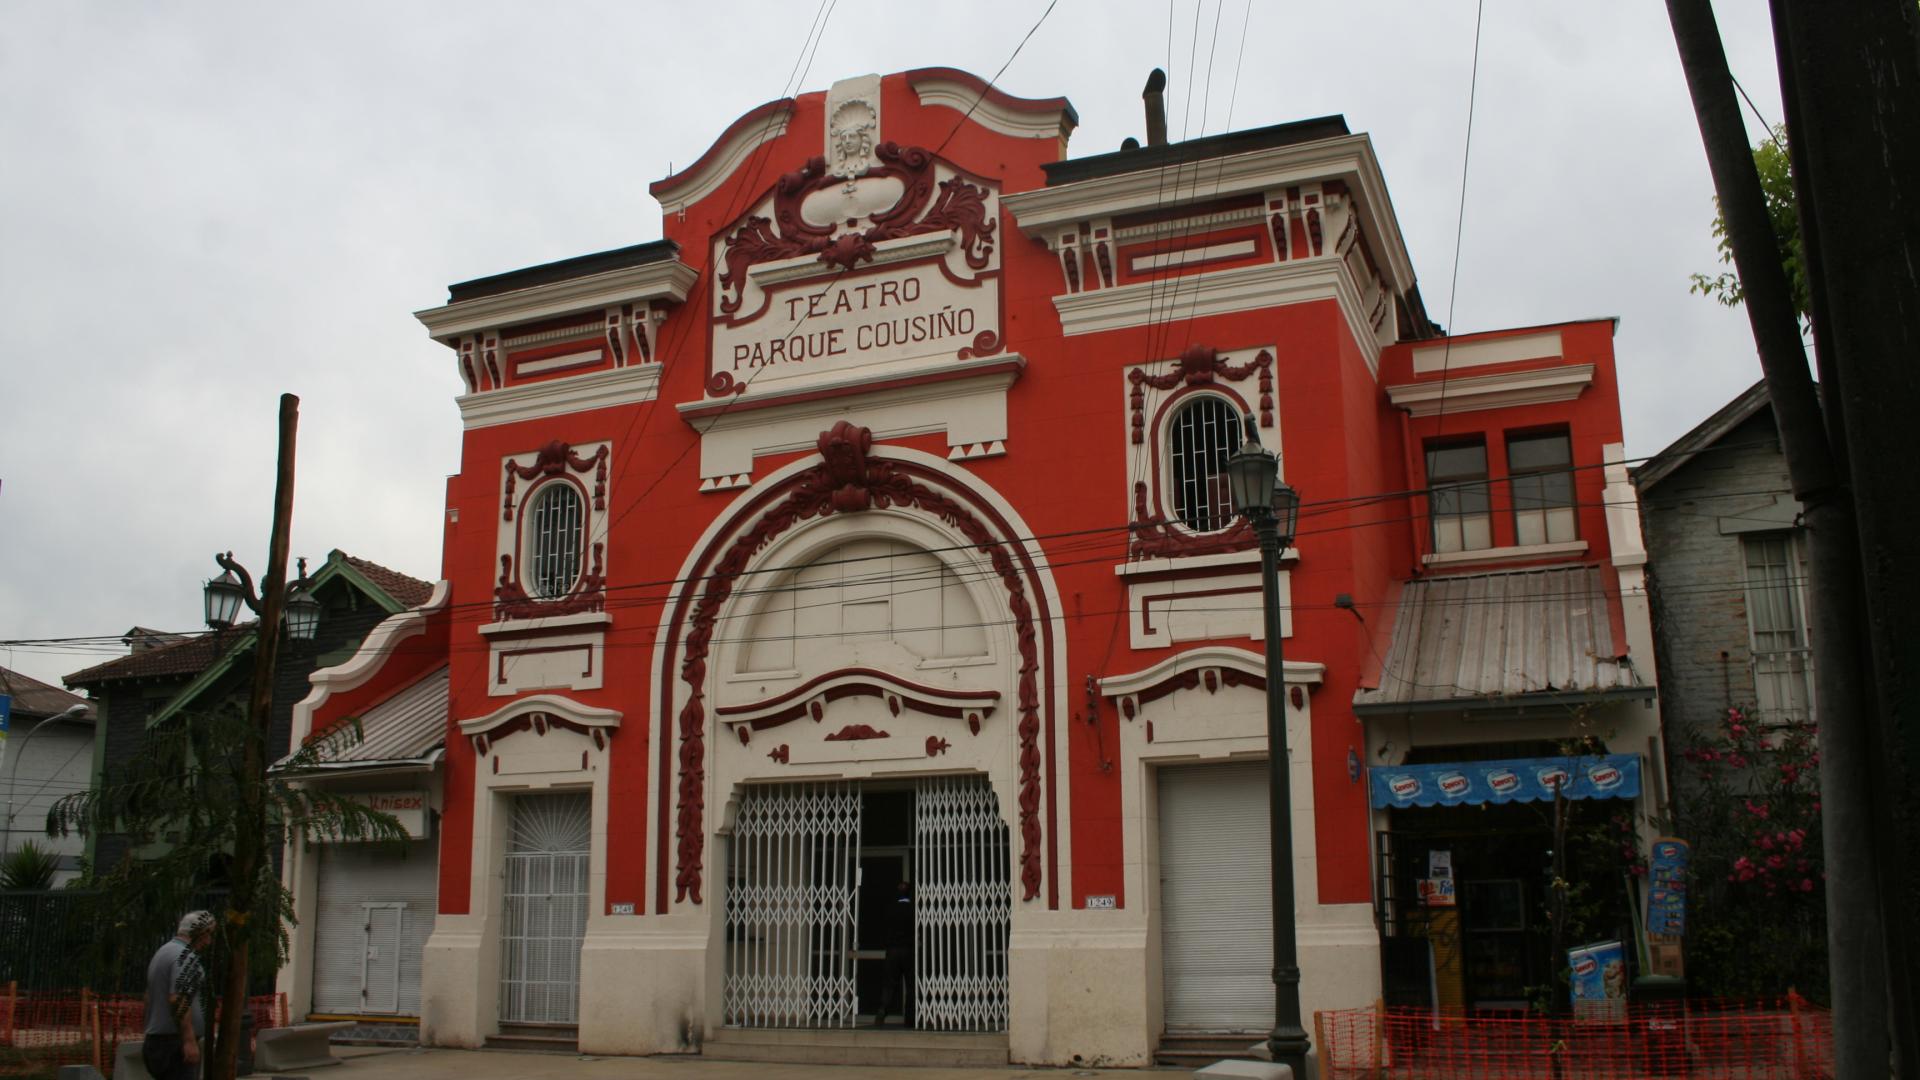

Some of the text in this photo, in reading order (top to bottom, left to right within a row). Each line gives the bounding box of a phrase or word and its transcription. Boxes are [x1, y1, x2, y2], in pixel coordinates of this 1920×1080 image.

[785, 277, 921, 322] TEATRO
[733, 305, 975, 370] PARQUE COUSIÑO
[1492, 776, 1515, 787] Savory
[1593, 770, 1617, 782] Savory
[1394, 782, 1416, 792] Savory
[1442, 779, 1465, 789] Savory
[370, 794, 422, 811] Unisex
